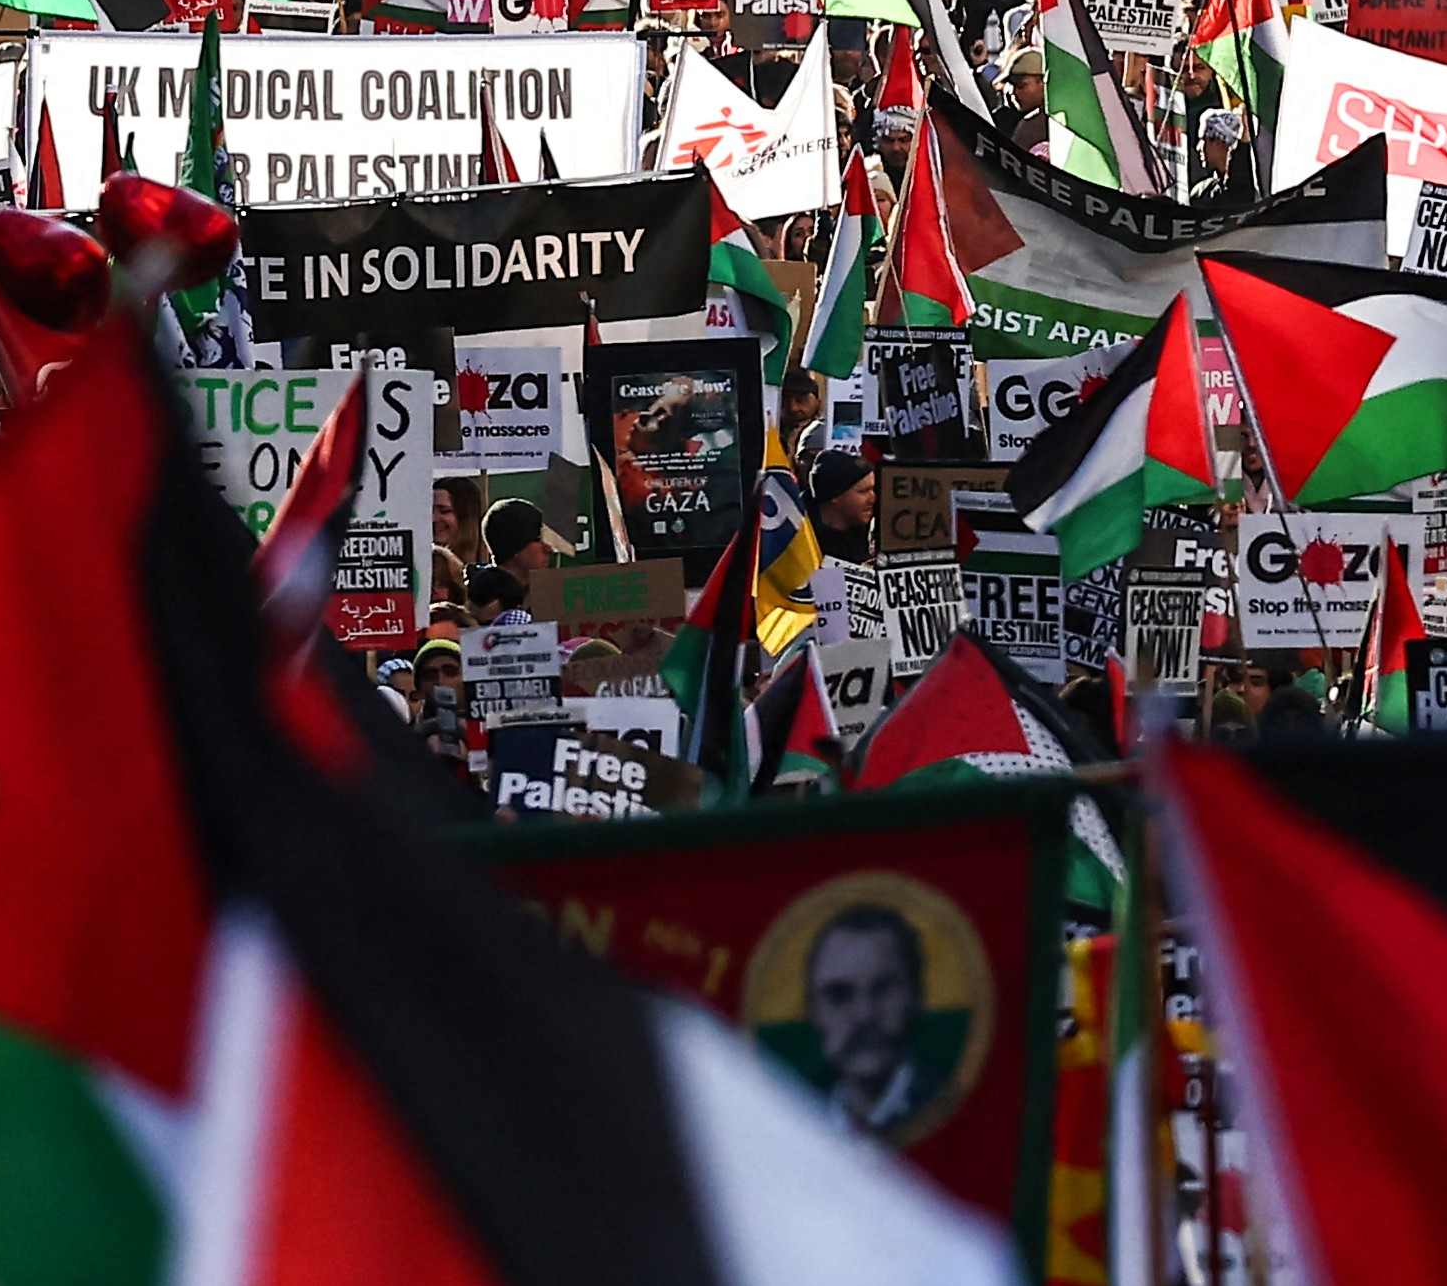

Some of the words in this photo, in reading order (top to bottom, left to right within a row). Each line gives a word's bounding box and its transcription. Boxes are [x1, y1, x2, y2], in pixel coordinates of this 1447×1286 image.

[1087, 4, 1174, 28] PALESTINE
[89, 67, 140, 117] UK
[158, 67, 343, 120] MDICAL
[360, 67, 574, 120] COALITION
[975, 133, 1073, 207] FREE
[303, 251, 354, 301] IN
[361, 227, 647, 292] SOLIDARITY
[971, 304, 1043, 338] SIST
[331, 343, 406, 370] Free
[488, 371, 548, 410] za
[899, 363, 936, 393] Free
[191, 377, 319, 435] TICE
[375, 381, 412, 441] S
[885, 393, 958, 440] Palestine
[474, 425, 550, 438] massacre
[646, 491, 711, 513] GAZA
[339, 536, 404, 558] REEDOM
[1175, 539, 1240, 576] Fre
[1246, 531, 1410, 584] Gza
[331, 568, 409, 592] ALESTINE
[962, 575, 1059, 622] FREE
[1130, 588, 1201, 625] CEASEFIRE
[1249, 598, 1285, 616] Stop
[1326, 600, 1371, 613] mass
[1137, 625, 1191, 683] NOW!
[553, 738, 647, 790] Free
